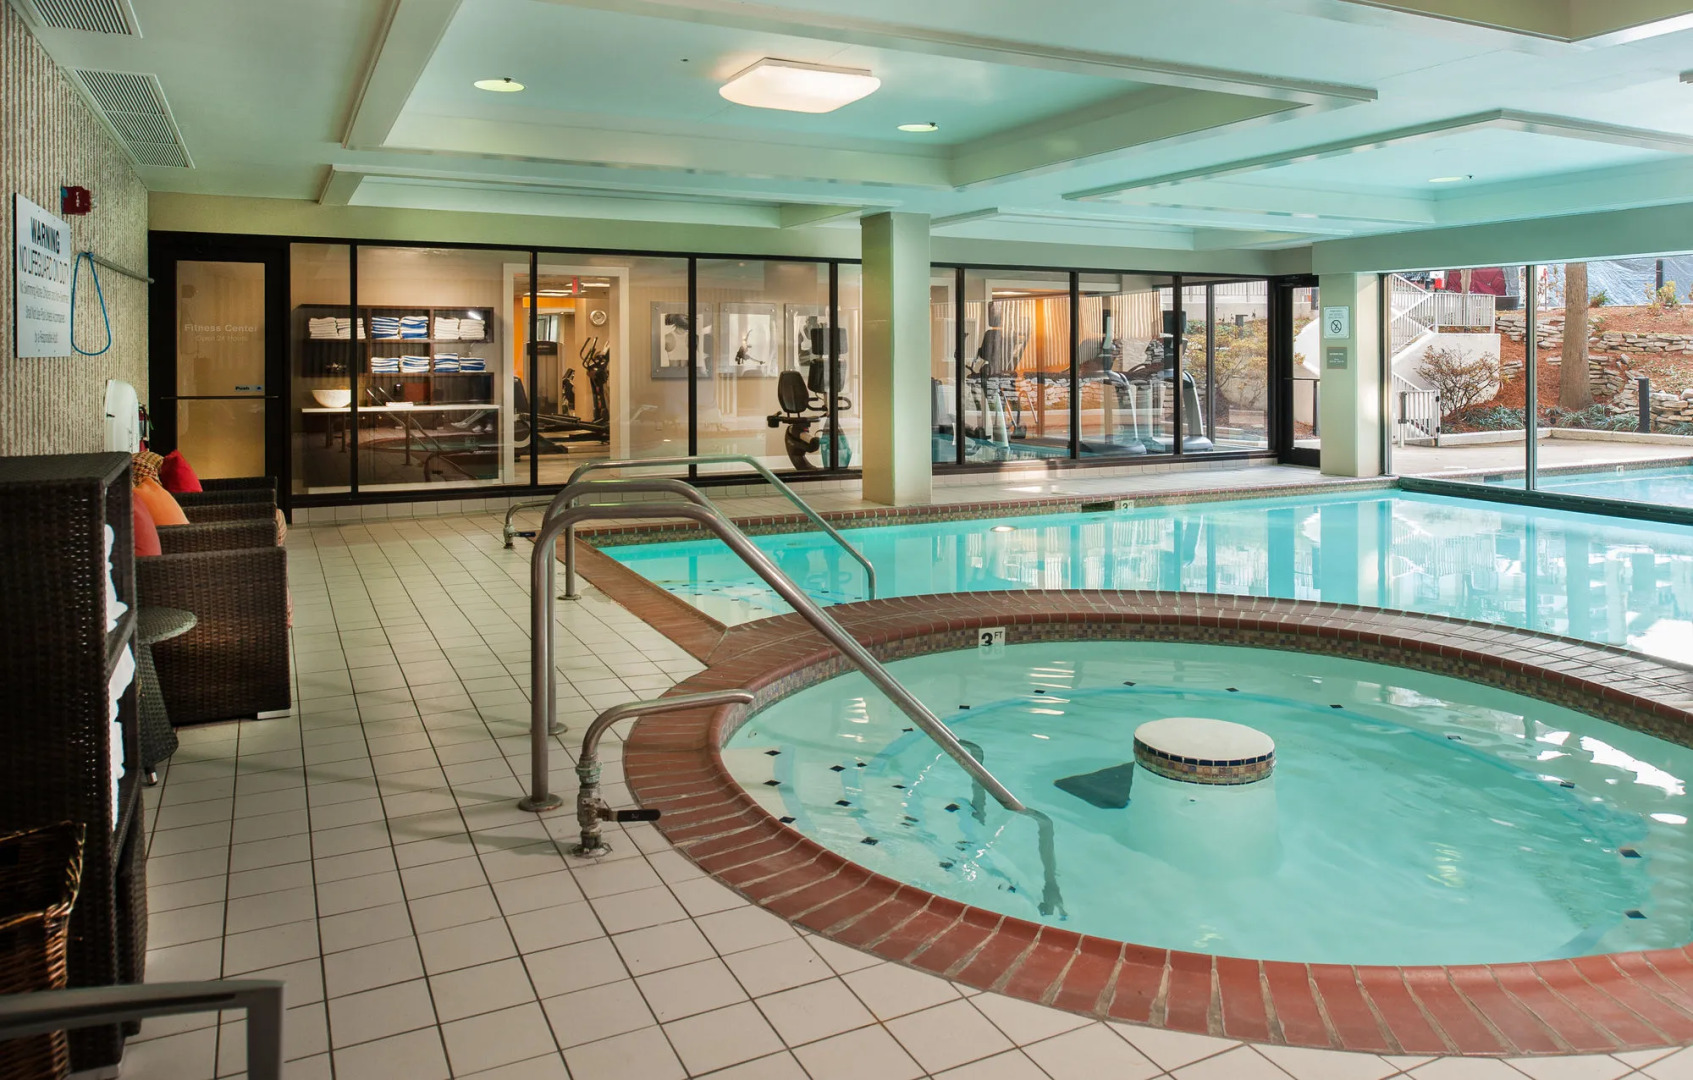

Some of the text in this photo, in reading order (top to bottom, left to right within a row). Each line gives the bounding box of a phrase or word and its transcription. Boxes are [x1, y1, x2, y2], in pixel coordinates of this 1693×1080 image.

[30, 216, 60, 254] WARNING
[184, 323, 257, 333] Fitness Center
